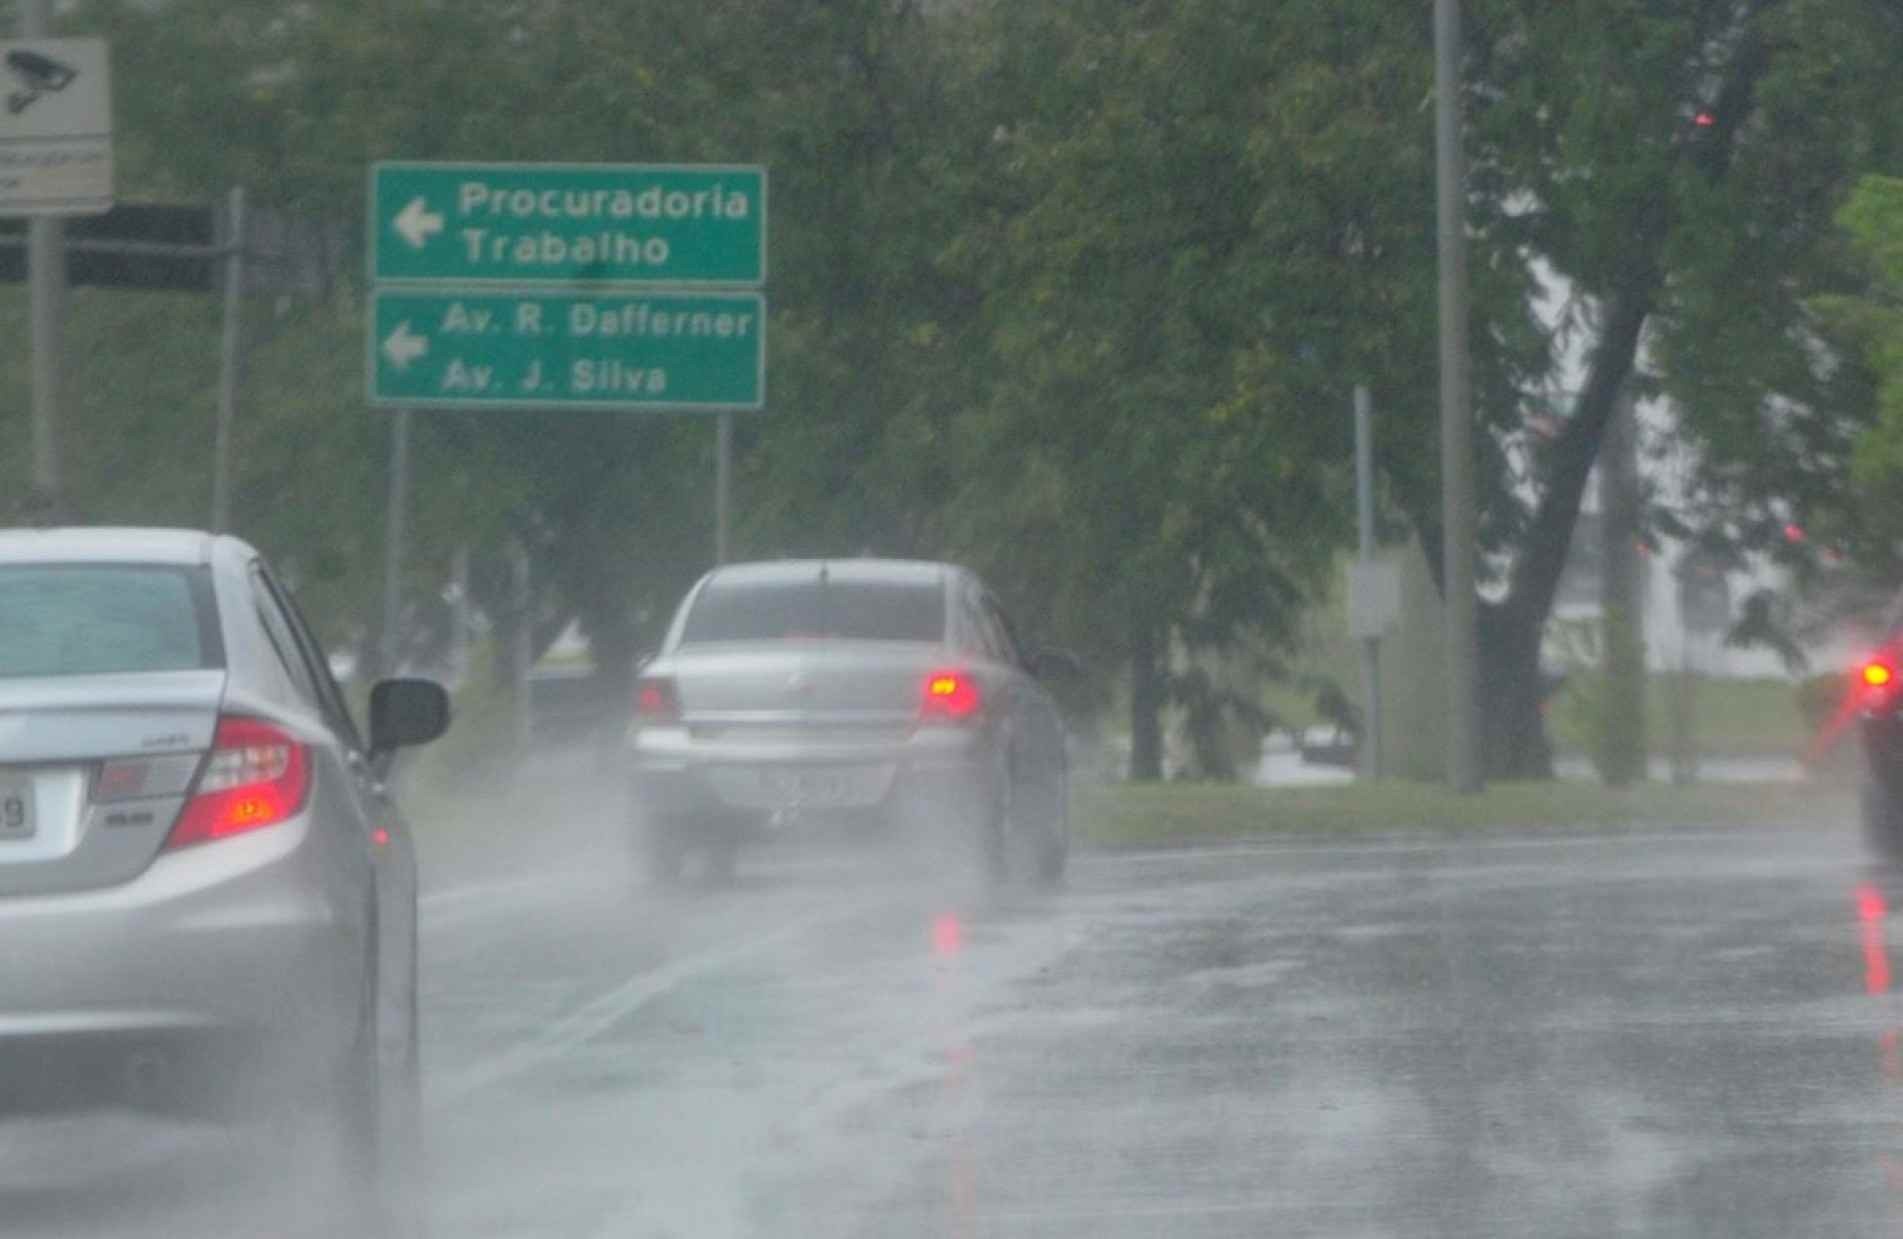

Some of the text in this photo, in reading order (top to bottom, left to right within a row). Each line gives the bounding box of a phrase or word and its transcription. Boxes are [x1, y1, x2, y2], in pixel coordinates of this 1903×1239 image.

[458, 182, 749, 219] Procuradoria
[462, 228, 670, 264] Trabalho
[440, 302, 501, 334] Av.
[516, 302, 556, 335] R.
[440, 358, 667, 393] Av. J. Silva
